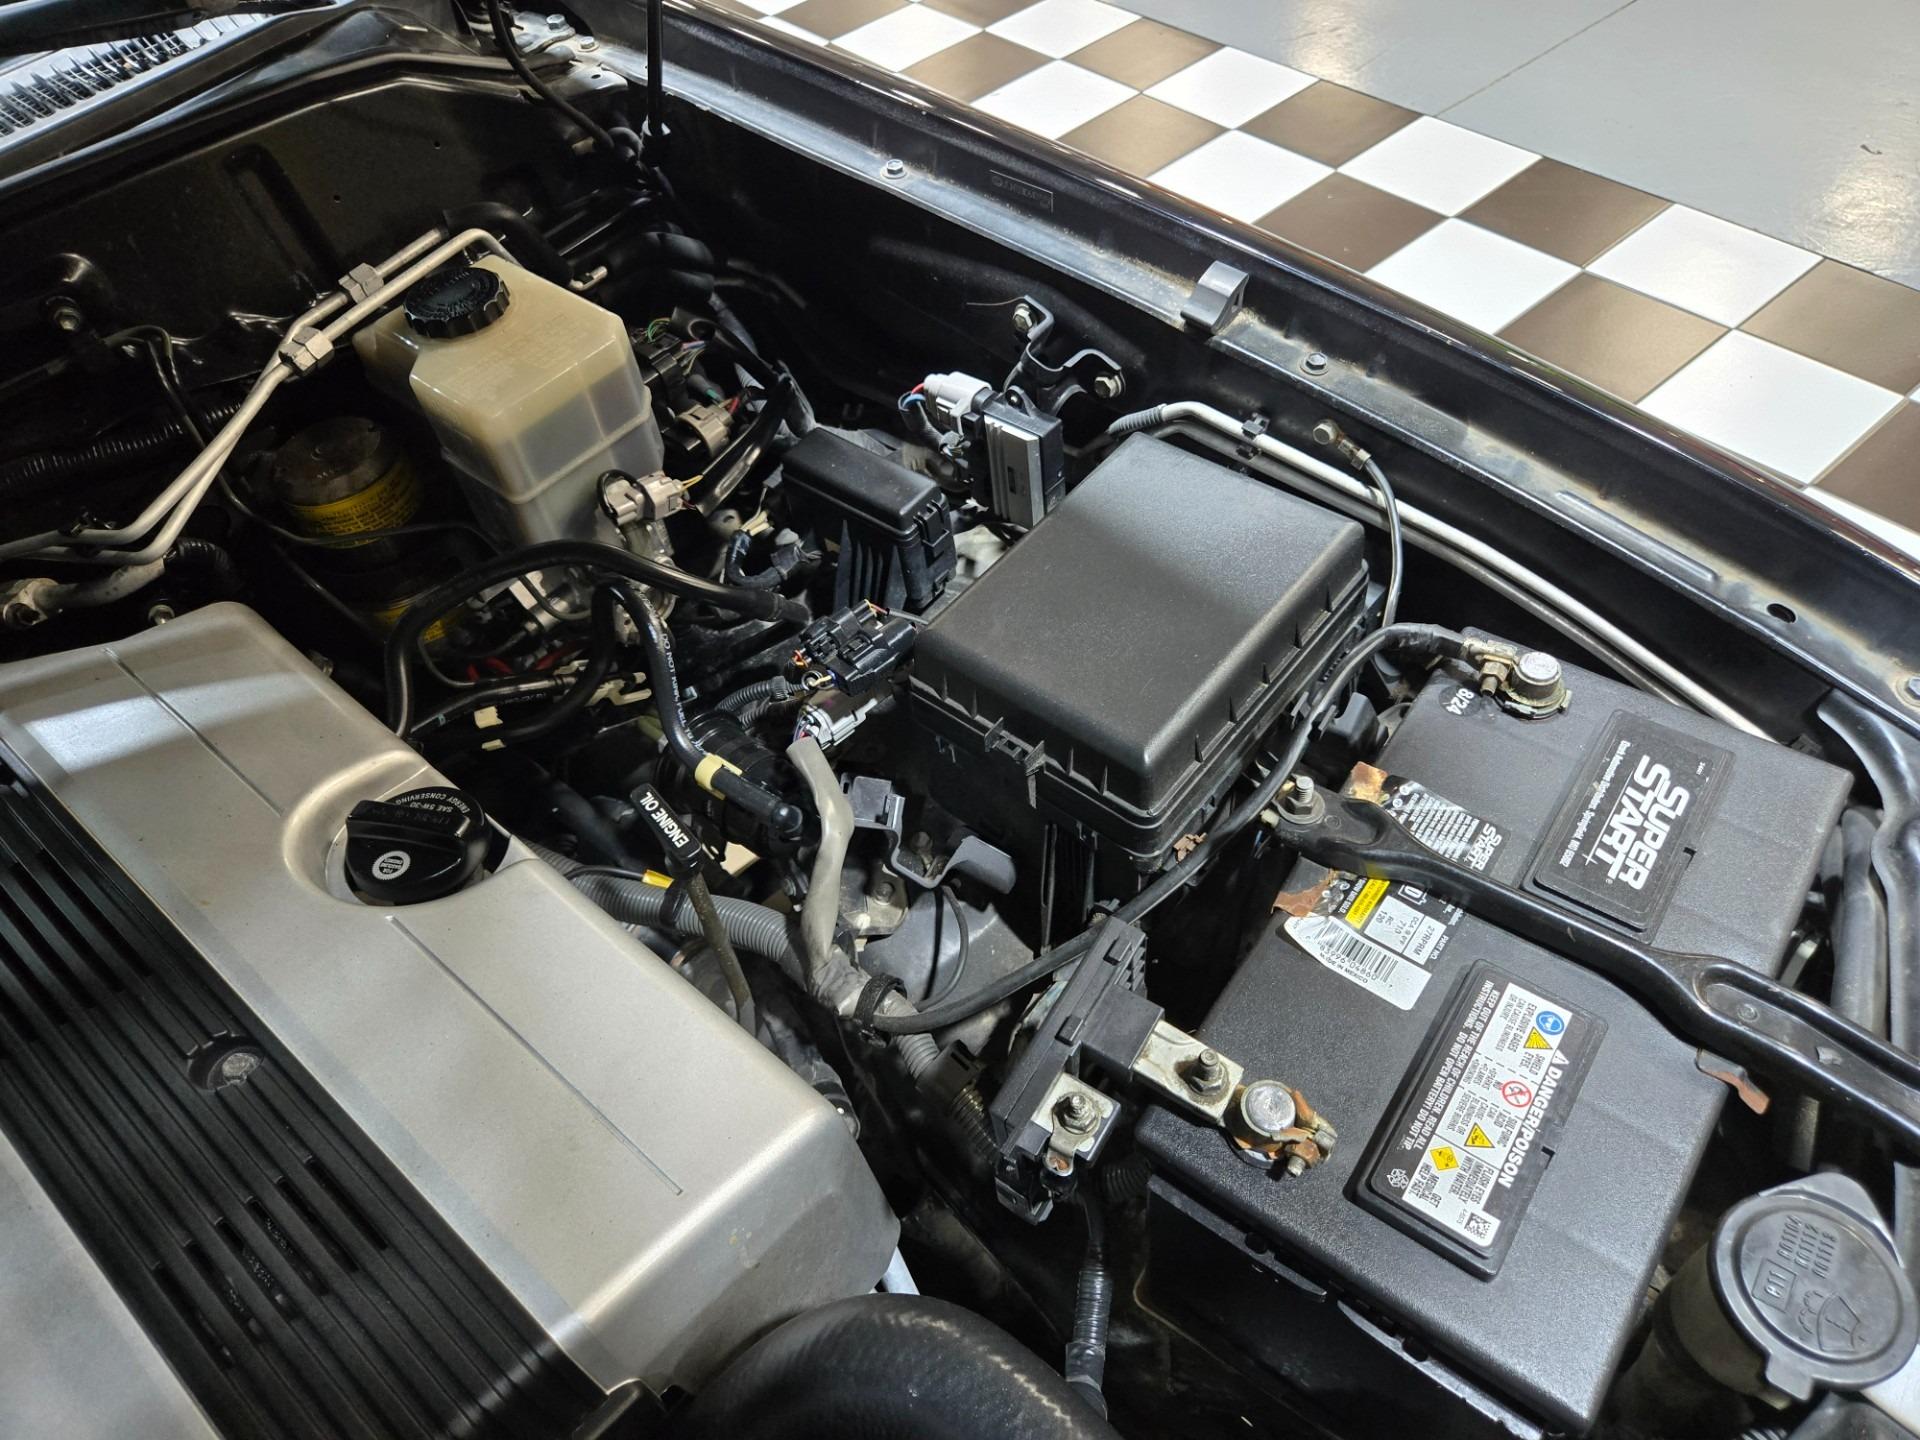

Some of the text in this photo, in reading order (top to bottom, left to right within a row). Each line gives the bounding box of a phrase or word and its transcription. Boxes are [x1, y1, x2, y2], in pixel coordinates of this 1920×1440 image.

[661, 633, 671, 649] DO
[664, 651, 677, 672] NOT
[1446, 688, 1475, 715] 8/24
[395, 792, 469, 812] ENERGY CONSERVING
[436, 804, 453, 812] SAE
[1593, 754, 1671, 879] START
[638, 790, 689, 848] ENGINE OIL
[1618, 778, 1690, 890] SUPER
[1469, 823, 1497, 864] START
[1471, 833, 1502, 871] SUPER
[1374, 909, 1388, 924] 120
[1412, 924, 1436, 956] 27RPRM
[1435, 934, 1449, 951] PART
[1494, 997, 1526, 1052] CAN CAUSE BLINDNESS
[1506, 1002, 1537, 1053] EXPLOSIVE GASES
[1400, 979, 1494, 1152] INSTRUCTIONS. DO NOT OPEN BATTERY! DO NOT TIP.
[1413, 988, 1500, 1151] KEEP OUT OF THE REACH OF CHILDREN. READ ALL
[1518, 1050, 1534, 1071] EYES.
[1528, 1053, 1545, 1076] SHIELD
[1492, 1079, 1503, 1091] NO
[1445, 1091, 1471, 1133] SEVERE BURNS.
[1455, 1096, 1479, 1136] BLINDNESS OR
[1473, 1101, 1488, 1121] CAUSE
[1485, 1105, 1497, 1119] CAN
[1492, 1110, 1507, 1129] ACID
[1496, 1064, 1563, 1189] DANGER/POISON
[1496, 1115, 1518, 1148] SULFURIC
[1458, 1154, 1474, 1174] WITH
[1408, 1162, 1432, 1198] HELP FAST.
[1418, 1172, 1439, 1202] MEDICAL
[1447, 1170, 1466, 1197] WATER.
[1457, 1159, 1484, 1204] IMMEDIATELY
[1469, 1165, 1494, 1205] FLUSH EYES
[1427, 1191, 1442, 1208] GET
